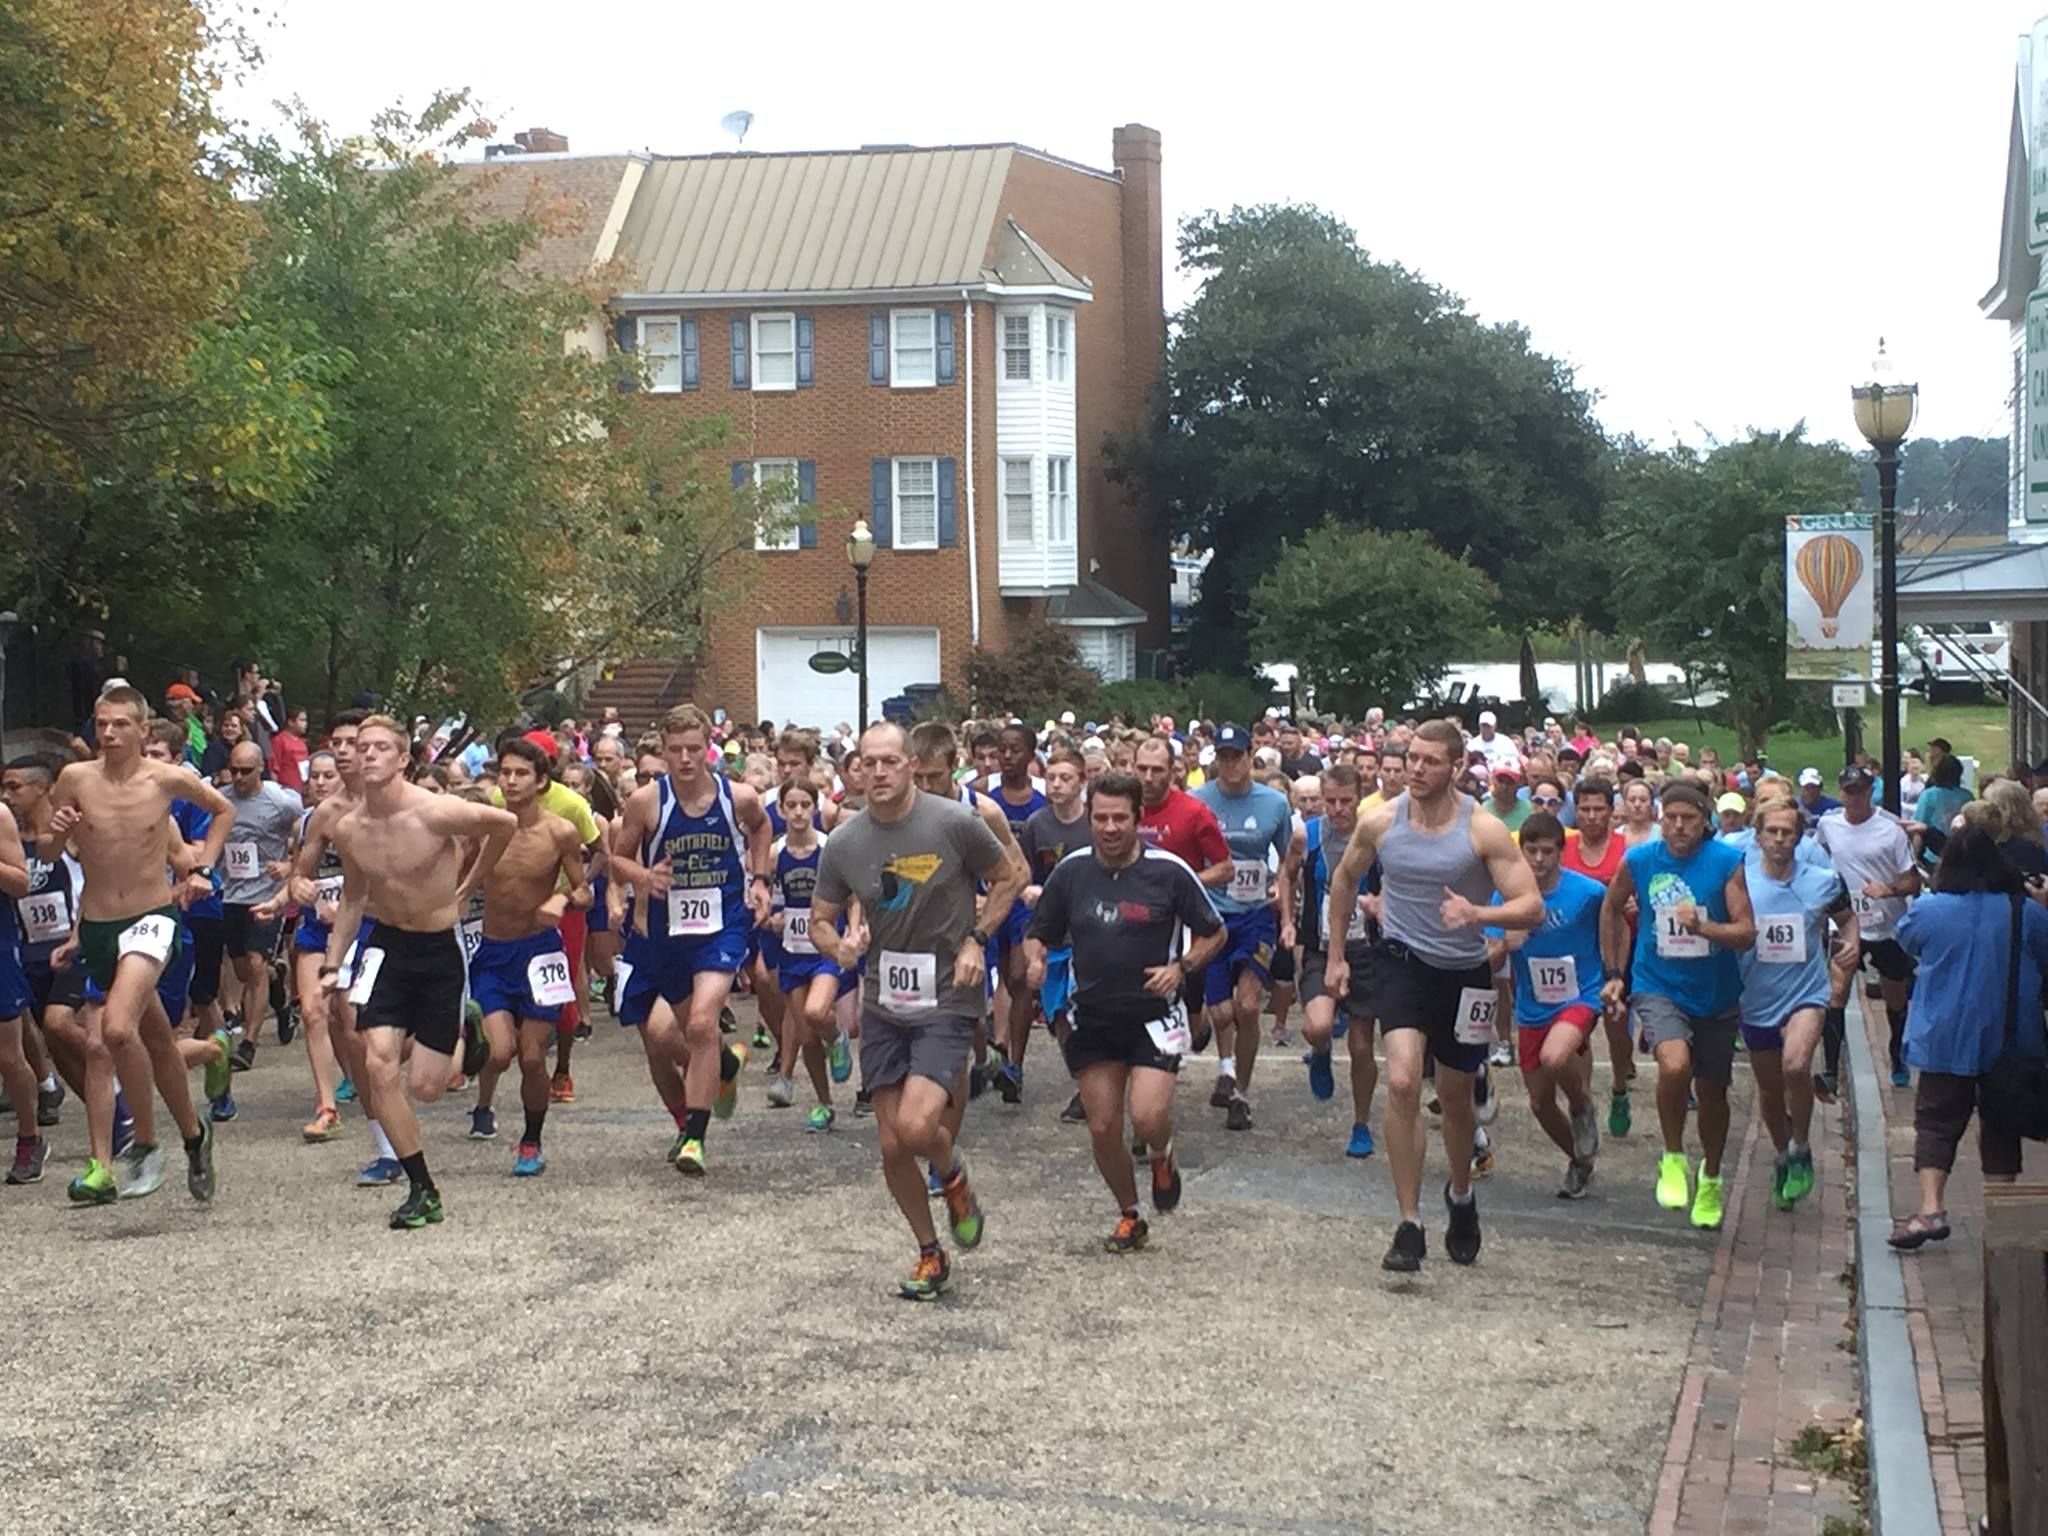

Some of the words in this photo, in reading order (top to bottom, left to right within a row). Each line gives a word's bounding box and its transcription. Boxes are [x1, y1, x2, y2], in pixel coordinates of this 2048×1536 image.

[30, 903, 57, 924] 338
[679, 900, 710, 920] 370
[1766, 925, 1795, 944] 463
[538, 962, 567, 985] 378
[889, 965, 920, 991] 601
[1540, 966, 1567, 986] 175
